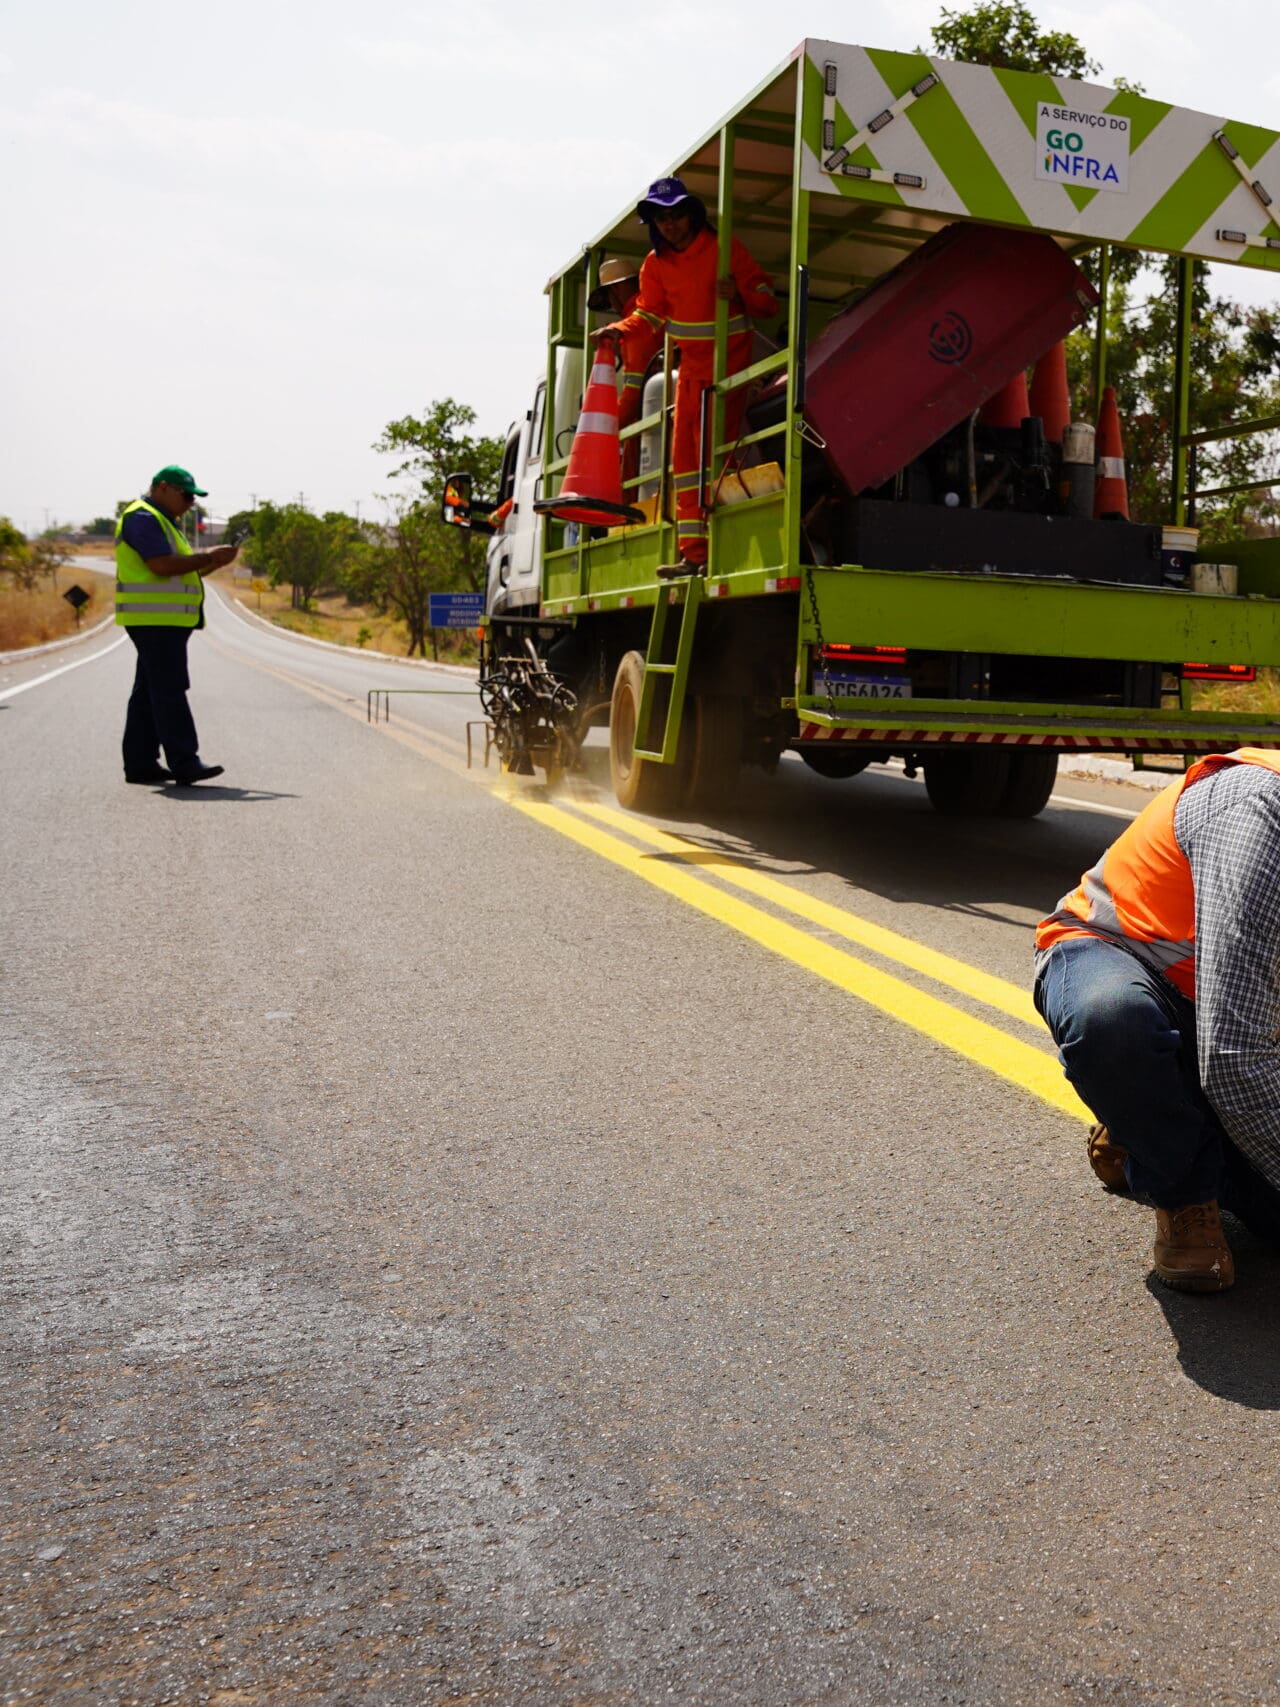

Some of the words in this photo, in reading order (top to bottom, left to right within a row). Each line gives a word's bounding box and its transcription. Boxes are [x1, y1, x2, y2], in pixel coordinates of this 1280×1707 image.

[1041, 106, 1050, 117] A
[1053, 108, 1107, 128] SERVIÇO
[1110, 119, 1128, 131] DO
[1046, 129, 1084, 153] GO
